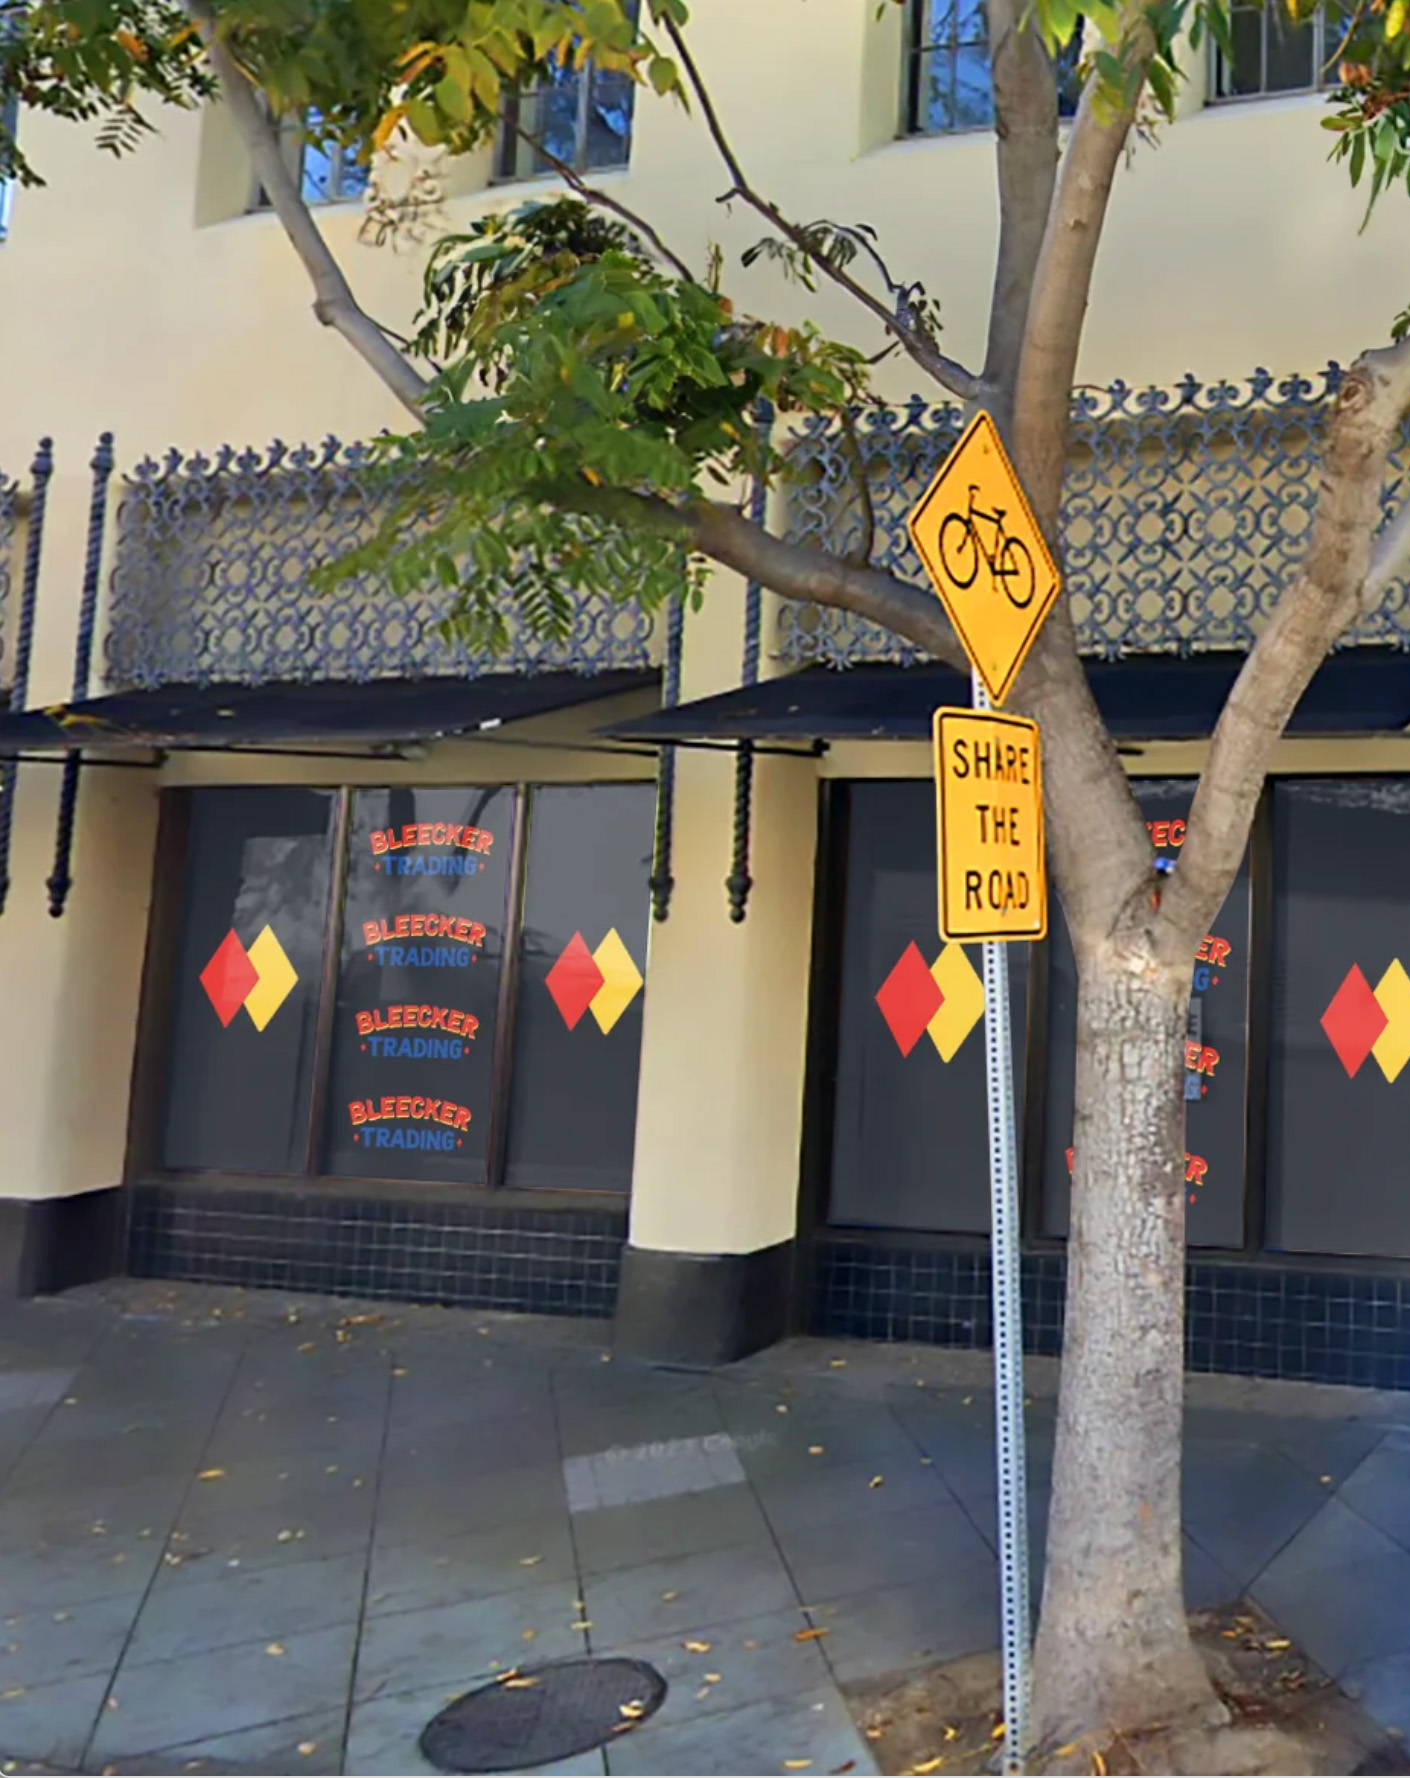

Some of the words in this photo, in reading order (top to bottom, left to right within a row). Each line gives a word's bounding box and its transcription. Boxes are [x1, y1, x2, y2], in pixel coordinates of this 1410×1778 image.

[953, 738, 1030, 785] SHARE
[370, 822, 494, 855] BLEECKER
[976, 804, 1021, 846] THE
[381, 855, 478, 877] TRADING
[965, 869, 1030, 911] ROAD
[363, 913, 487, 947] BLEECKER
[374, 945, 471, 968] TRADING
[356, 1004, 480, 1039] BLEECKER
[367, 1035, 463, 1060] TRADING
[348, 1095, 472, 1132] BLEECKER
[359, 1126, 456, 1151] TRADING
